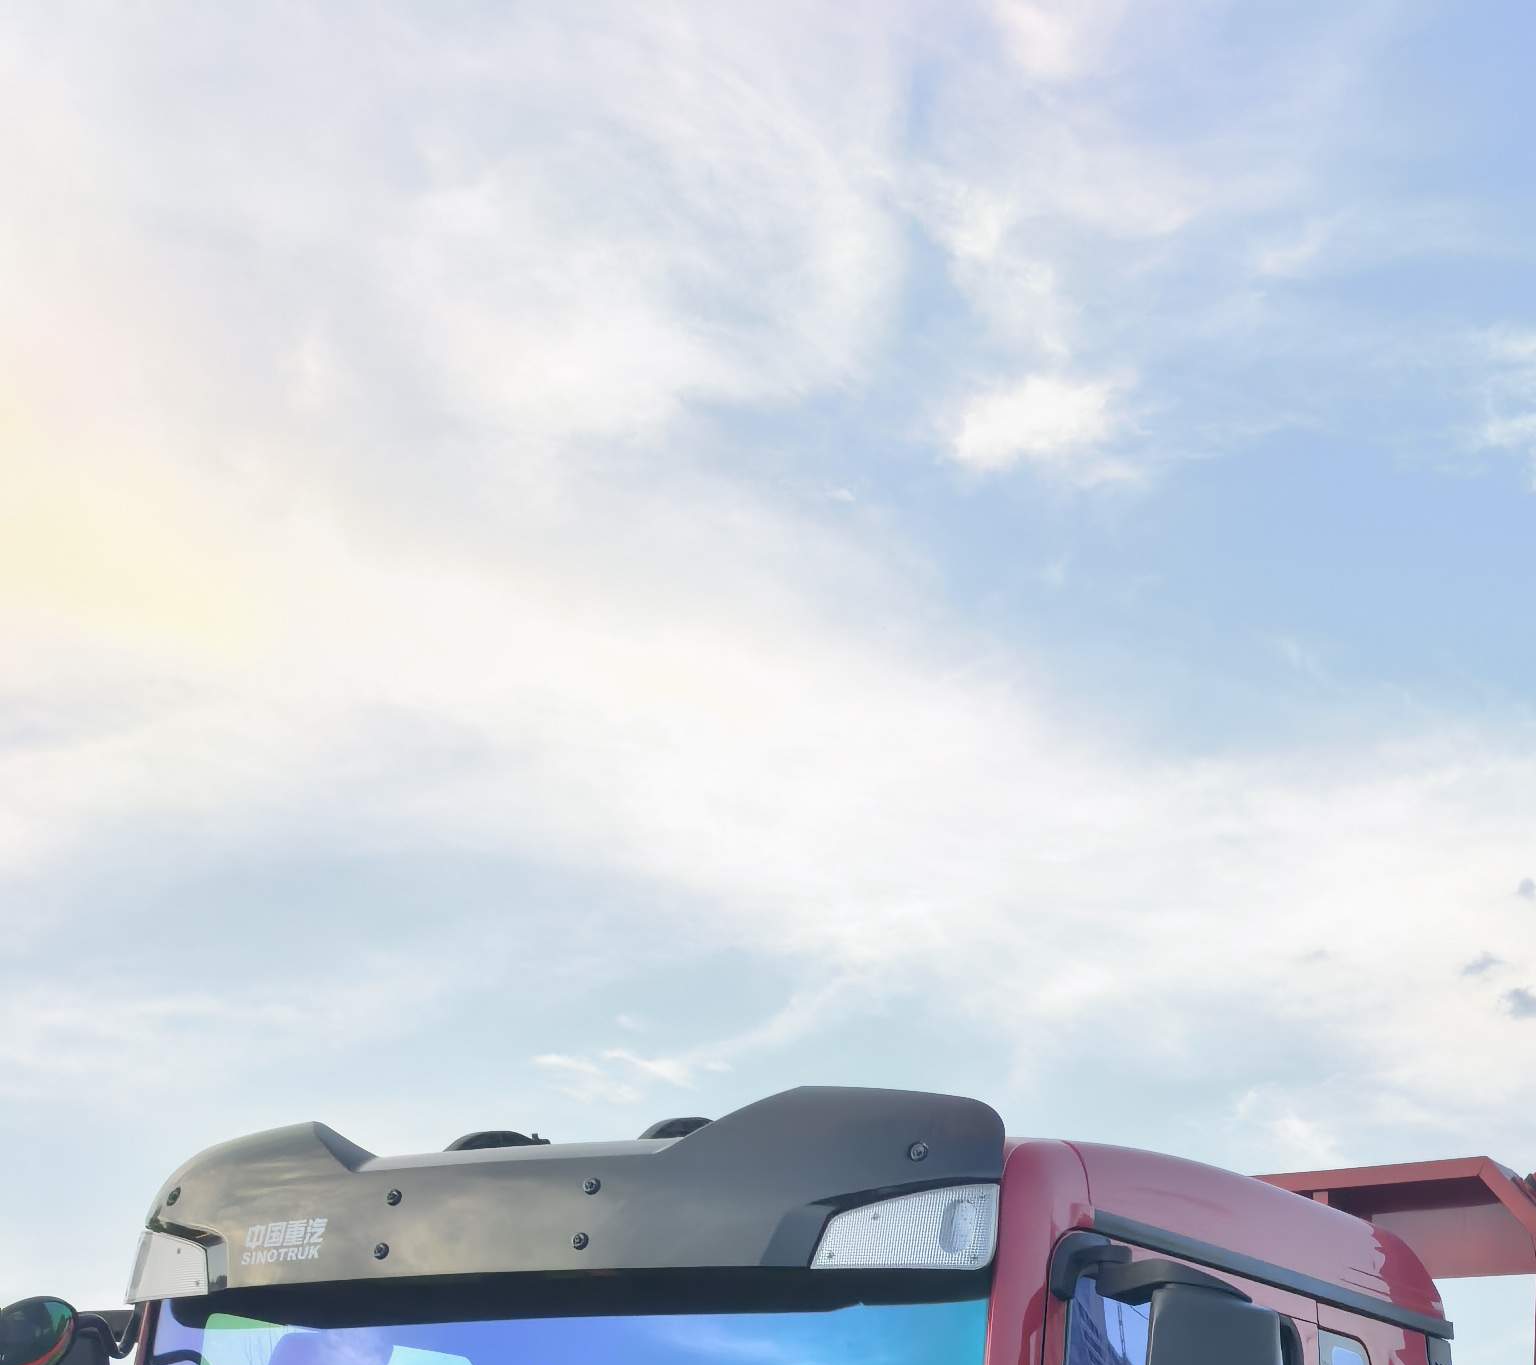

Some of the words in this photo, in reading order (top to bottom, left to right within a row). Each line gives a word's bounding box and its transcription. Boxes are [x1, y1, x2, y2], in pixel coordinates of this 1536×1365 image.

[245, 1218, 328, 1248] 中国重汽
[241, 1246, 320, 1264] SINOTRUK
